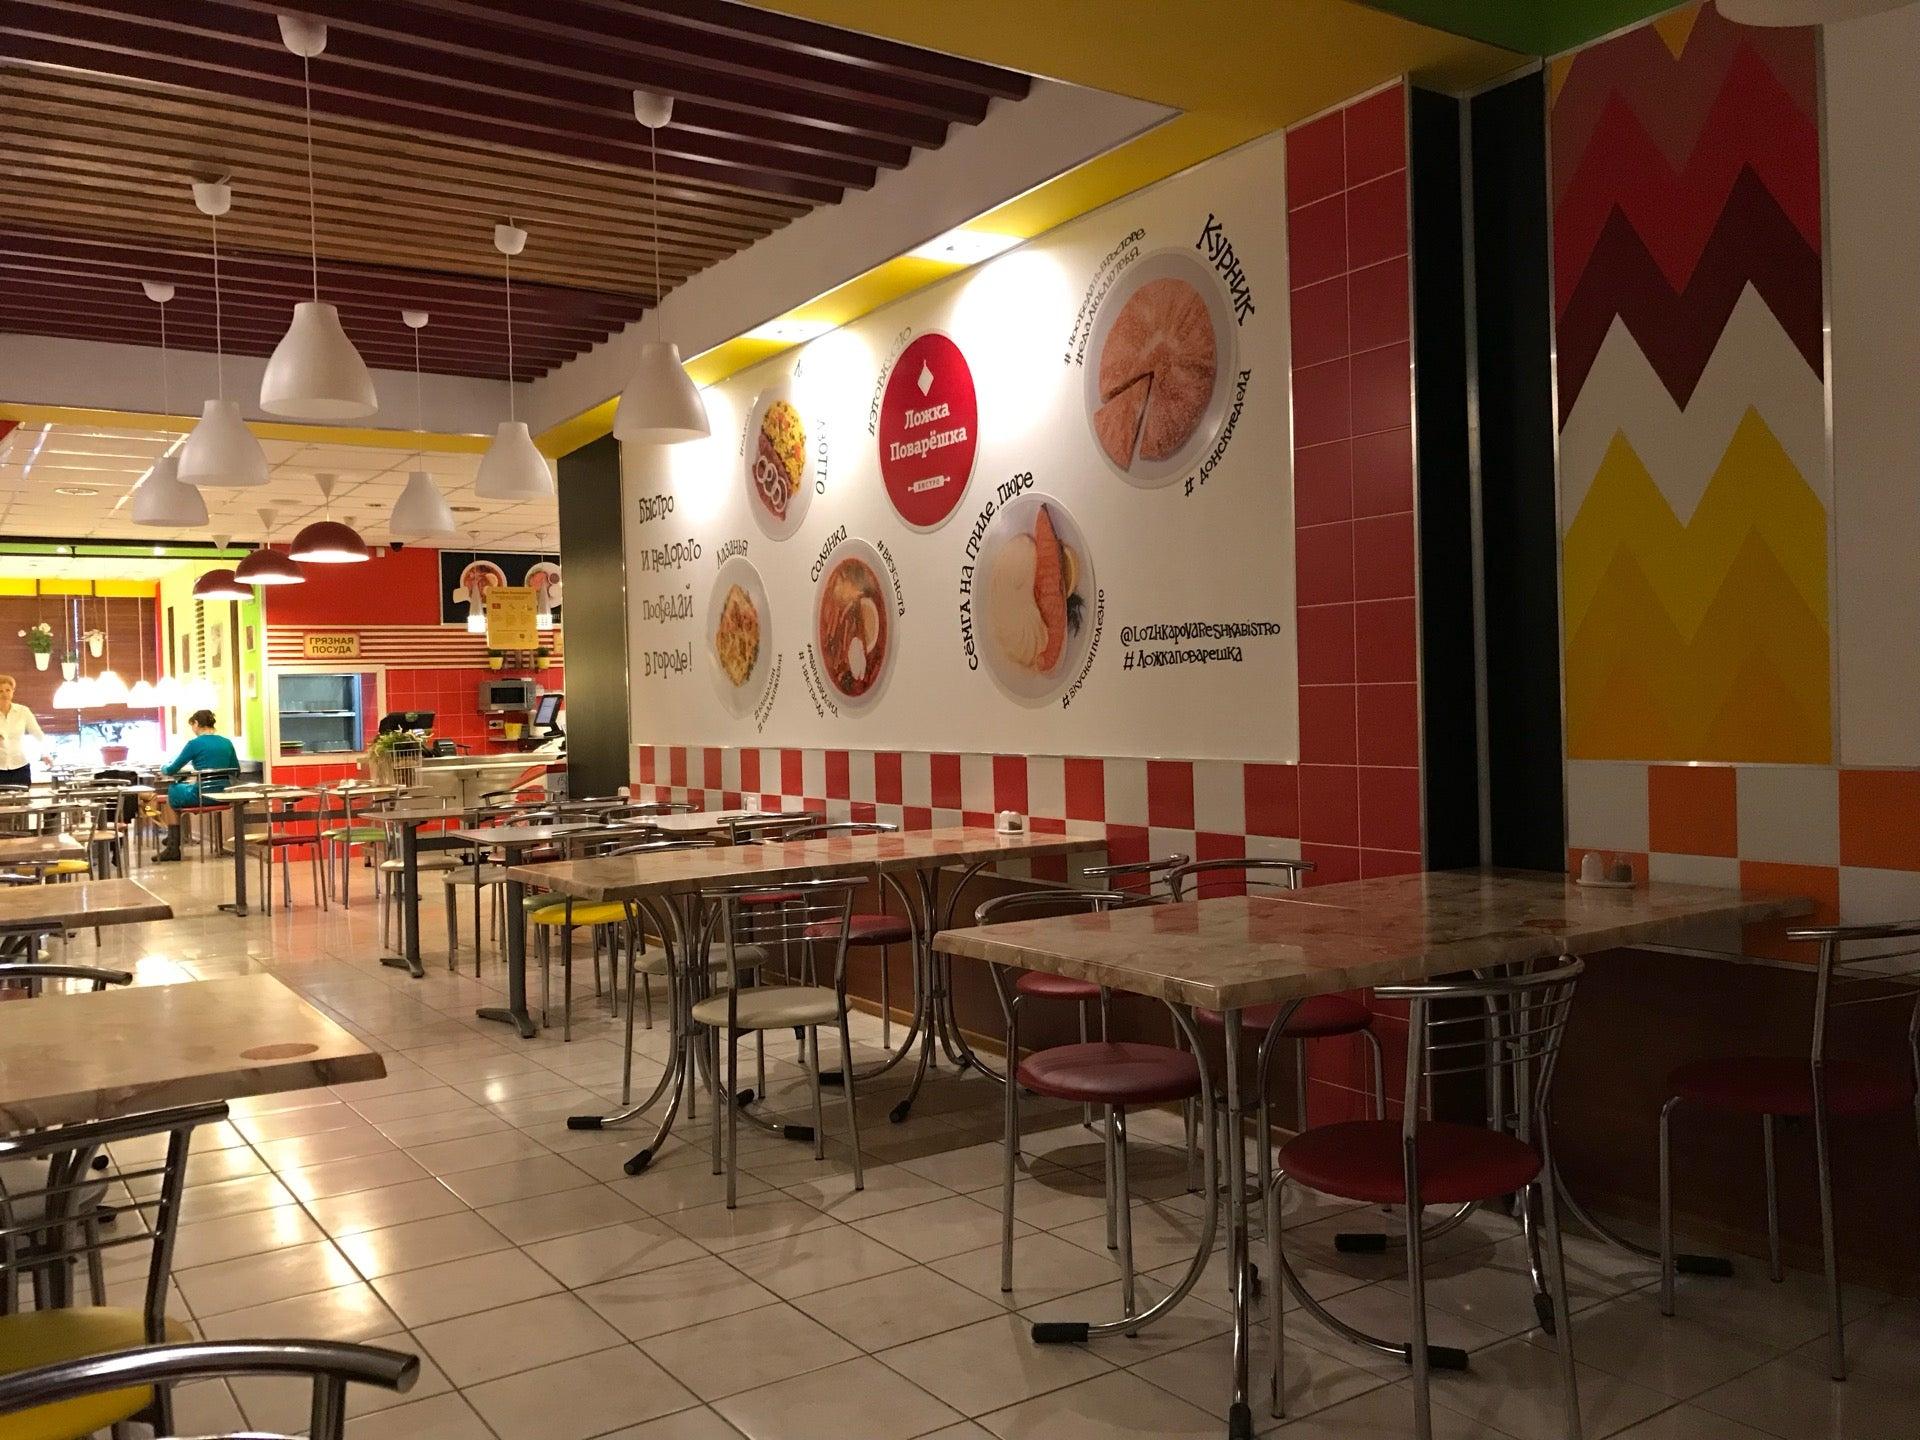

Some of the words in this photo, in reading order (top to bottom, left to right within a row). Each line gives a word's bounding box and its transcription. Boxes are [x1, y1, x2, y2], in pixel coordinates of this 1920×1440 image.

[904, 402, 950, 430] Ложка
[890, 425, 967, 461] Поварёшка
[309, 637, 354, 645] ГРЯЗНАЯ
[312, 645, 353, 654] ПОСУДА
